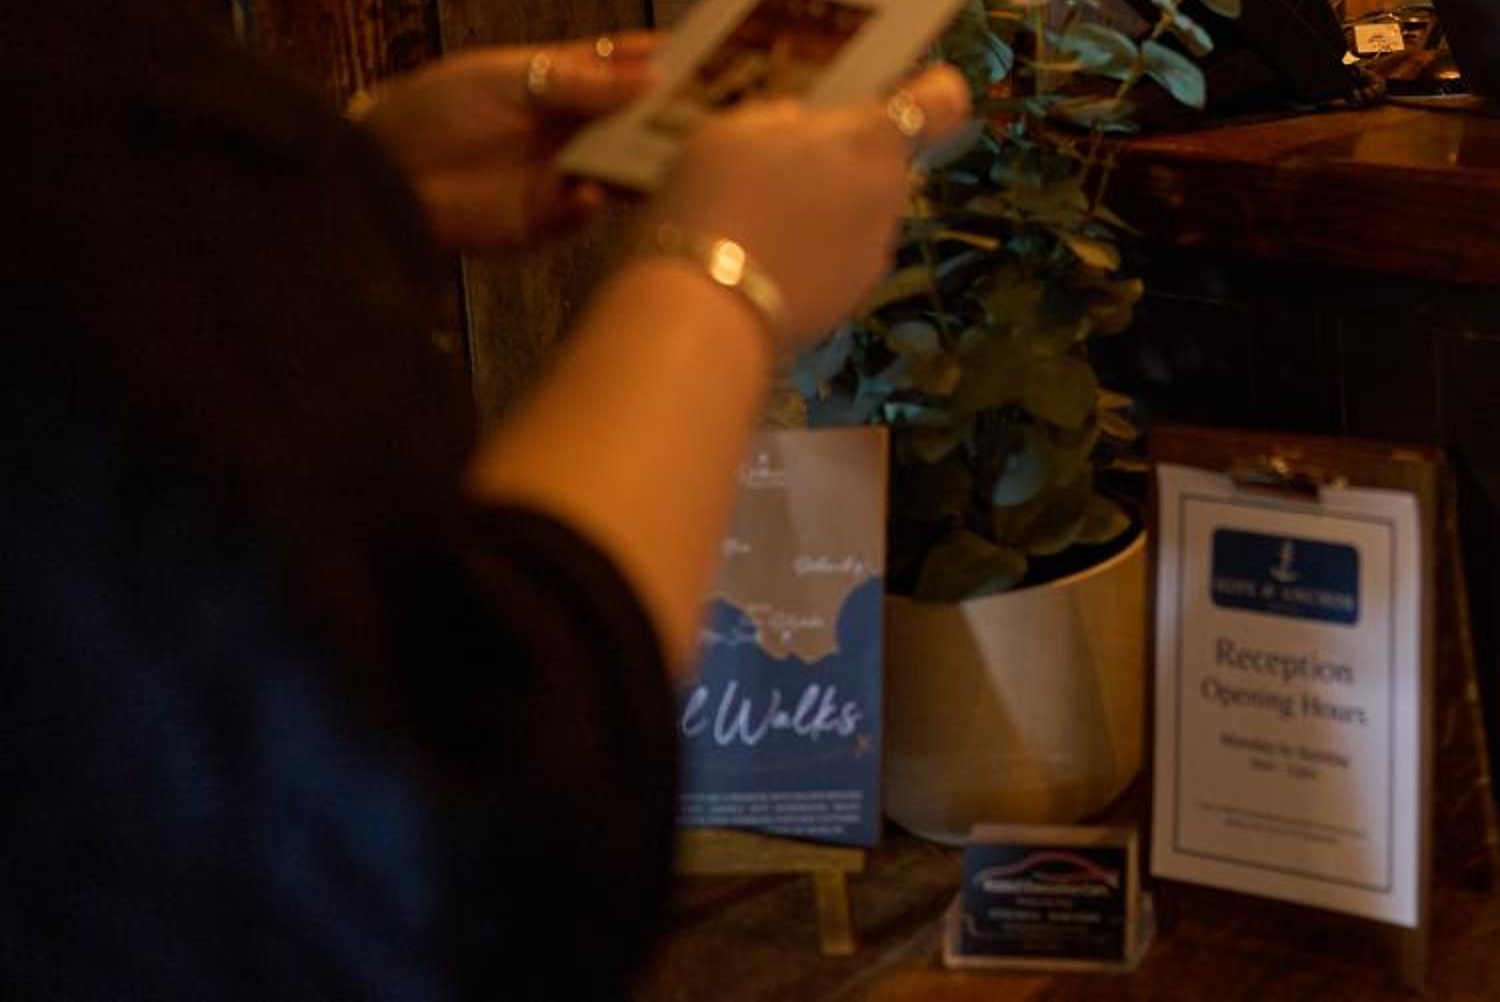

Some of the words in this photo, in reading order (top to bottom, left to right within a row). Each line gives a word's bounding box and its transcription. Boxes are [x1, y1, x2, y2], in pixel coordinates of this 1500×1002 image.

[1215, 636, 1354, 685] Reception
[713, 680, 863, 746] Walks
[1200, 676, 1294, 720] Opening
[1301, 692, 1369, 727] Hours
